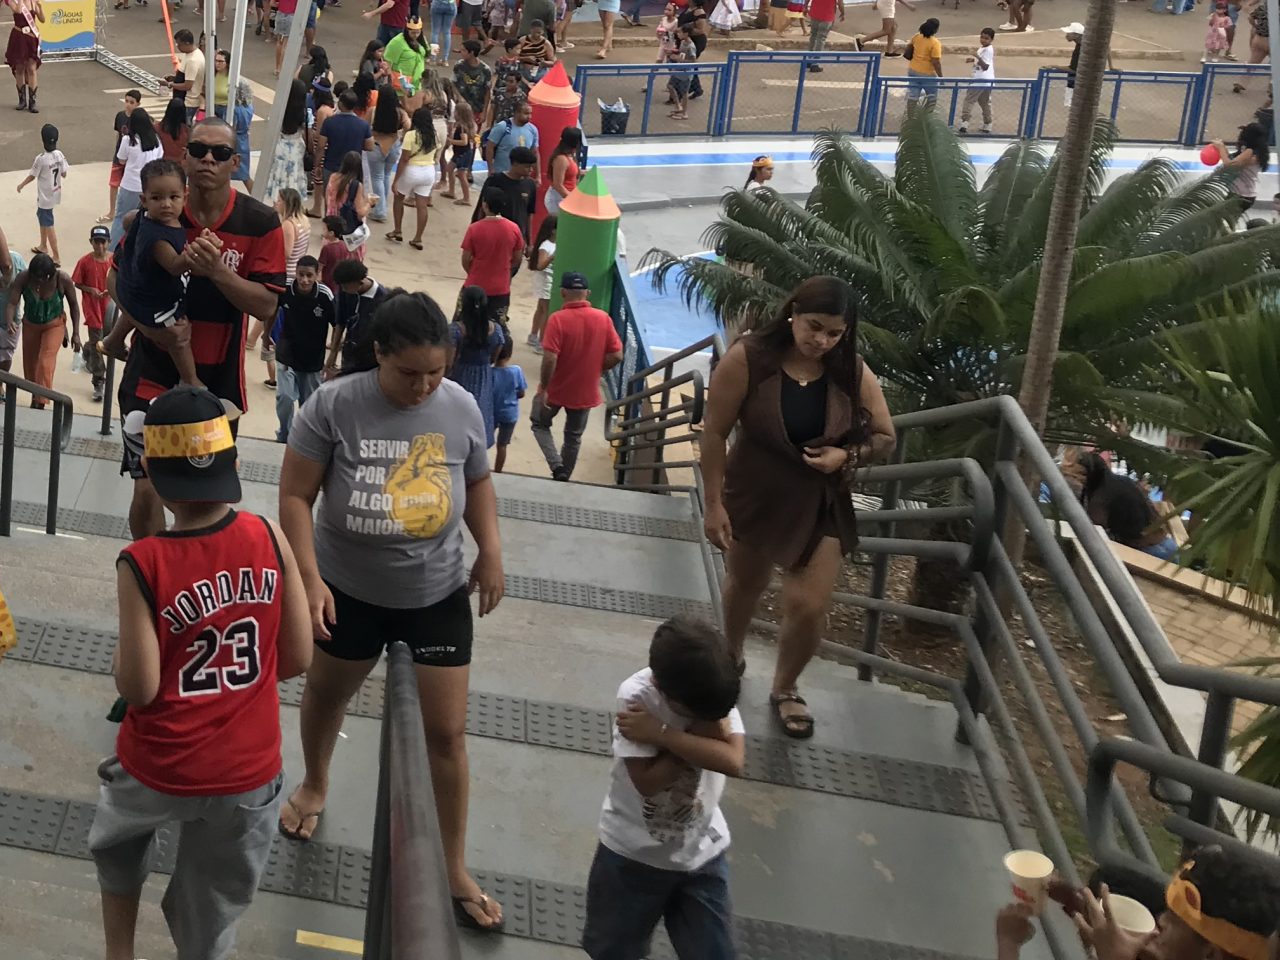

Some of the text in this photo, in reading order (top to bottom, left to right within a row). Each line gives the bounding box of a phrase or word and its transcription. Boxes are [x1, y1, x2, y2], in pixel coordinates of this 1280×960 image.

[52, 168, 60, 187] 7
[359, 439, 410, 458] SERVIR
[355, 465, 386, 484] POR
[348, 490, 393, 511] ALGO
[346, 514, 405, 536] MAIOR
[161, 567, 277, 634] JORDAN
[179, 616, 262, 698] 23
